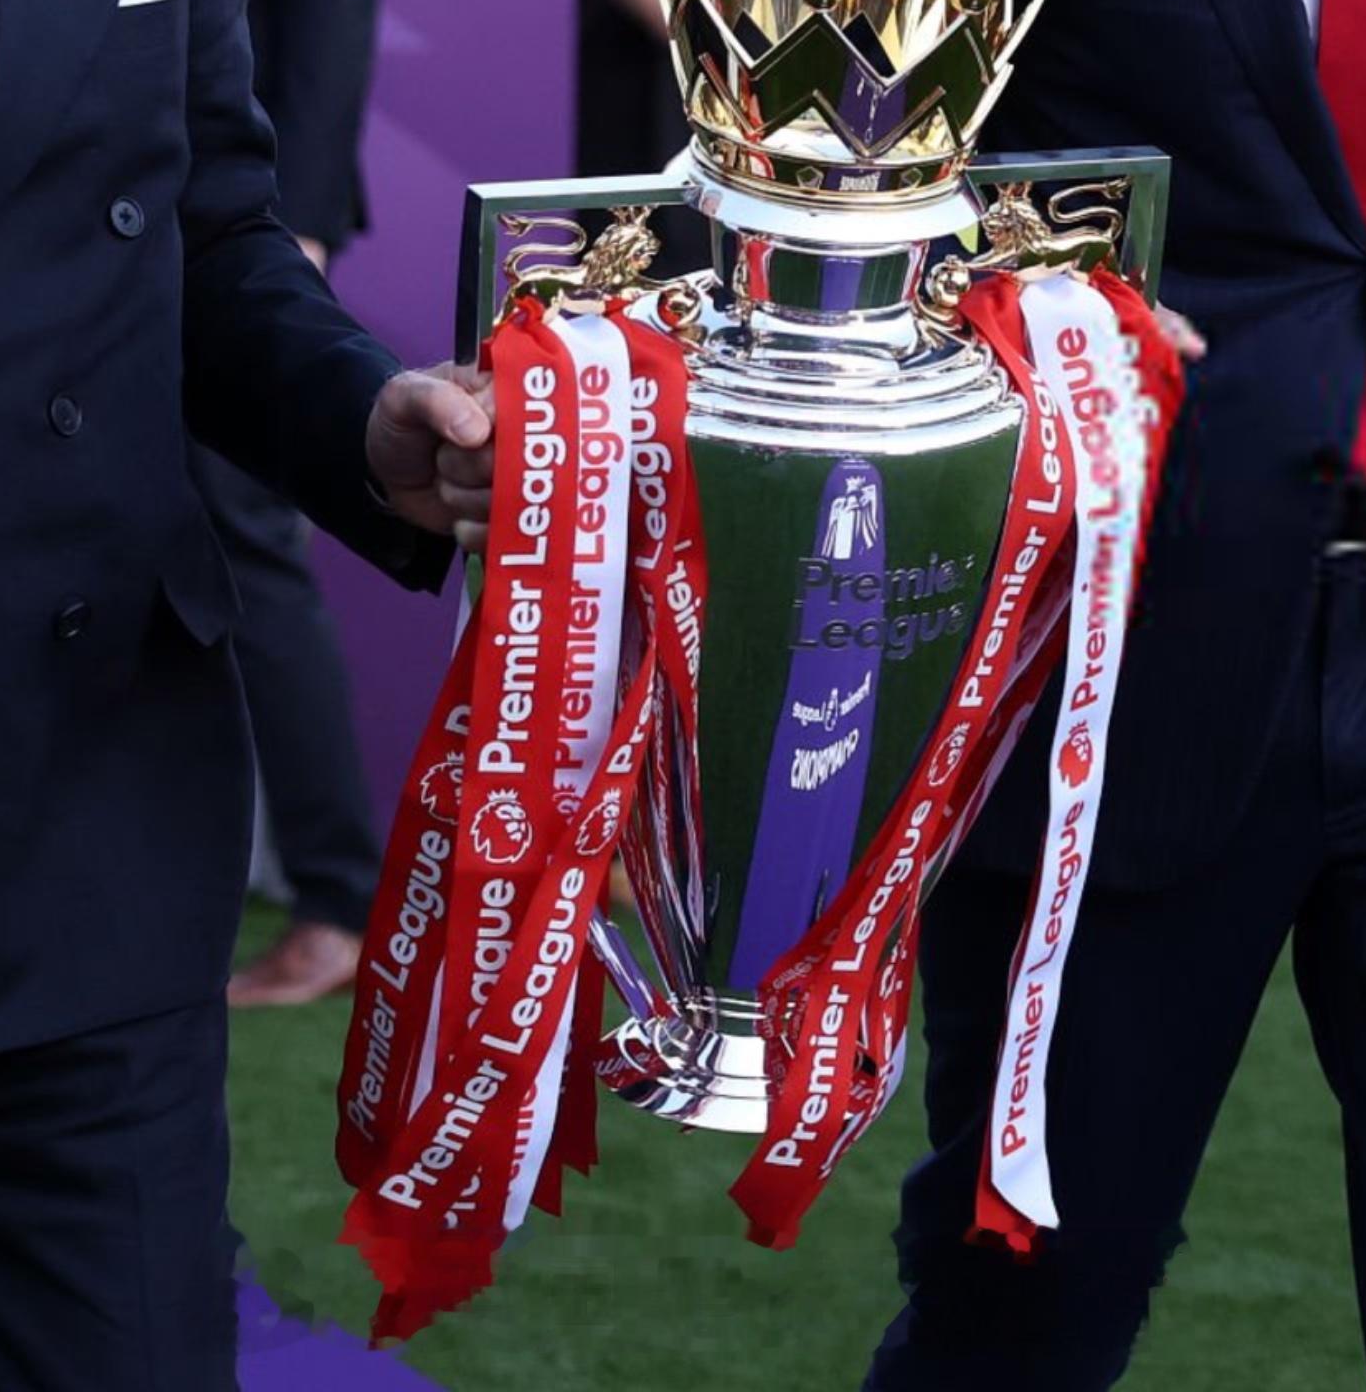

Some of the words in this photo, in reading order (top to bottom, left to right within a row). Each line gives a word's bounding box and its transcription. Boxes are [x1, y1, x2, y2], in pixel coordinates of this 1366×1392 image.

[501, 364, 567, 566] League
[575, 363, 624, 565] League
[631, 376, 674, 571] League
[1055, 326, 1123, 523] League
[789, 601, 967, 661] League
[794, 552, 976, 608] Premier
[958, 527, 1048, 709] Premier
[1026, 370, 1063, 516] Leag
[1071, 530, 1122, 713] Premier
[478, 579, 544, 775] Premier
[554, 582, 601, 771] Premier
[370, 828, 452, 994] League
[765, 983, 851, 1168] Premier
[832, 799, 932, 975] League
[1001, 982, 1045, 1157] Premier
[1028, 800, 1085, 976] League
[345, 991, 400, 1143] Premier
[378, 1059, 508, 1210] Premier
[481, 867, 586, 1057] League
